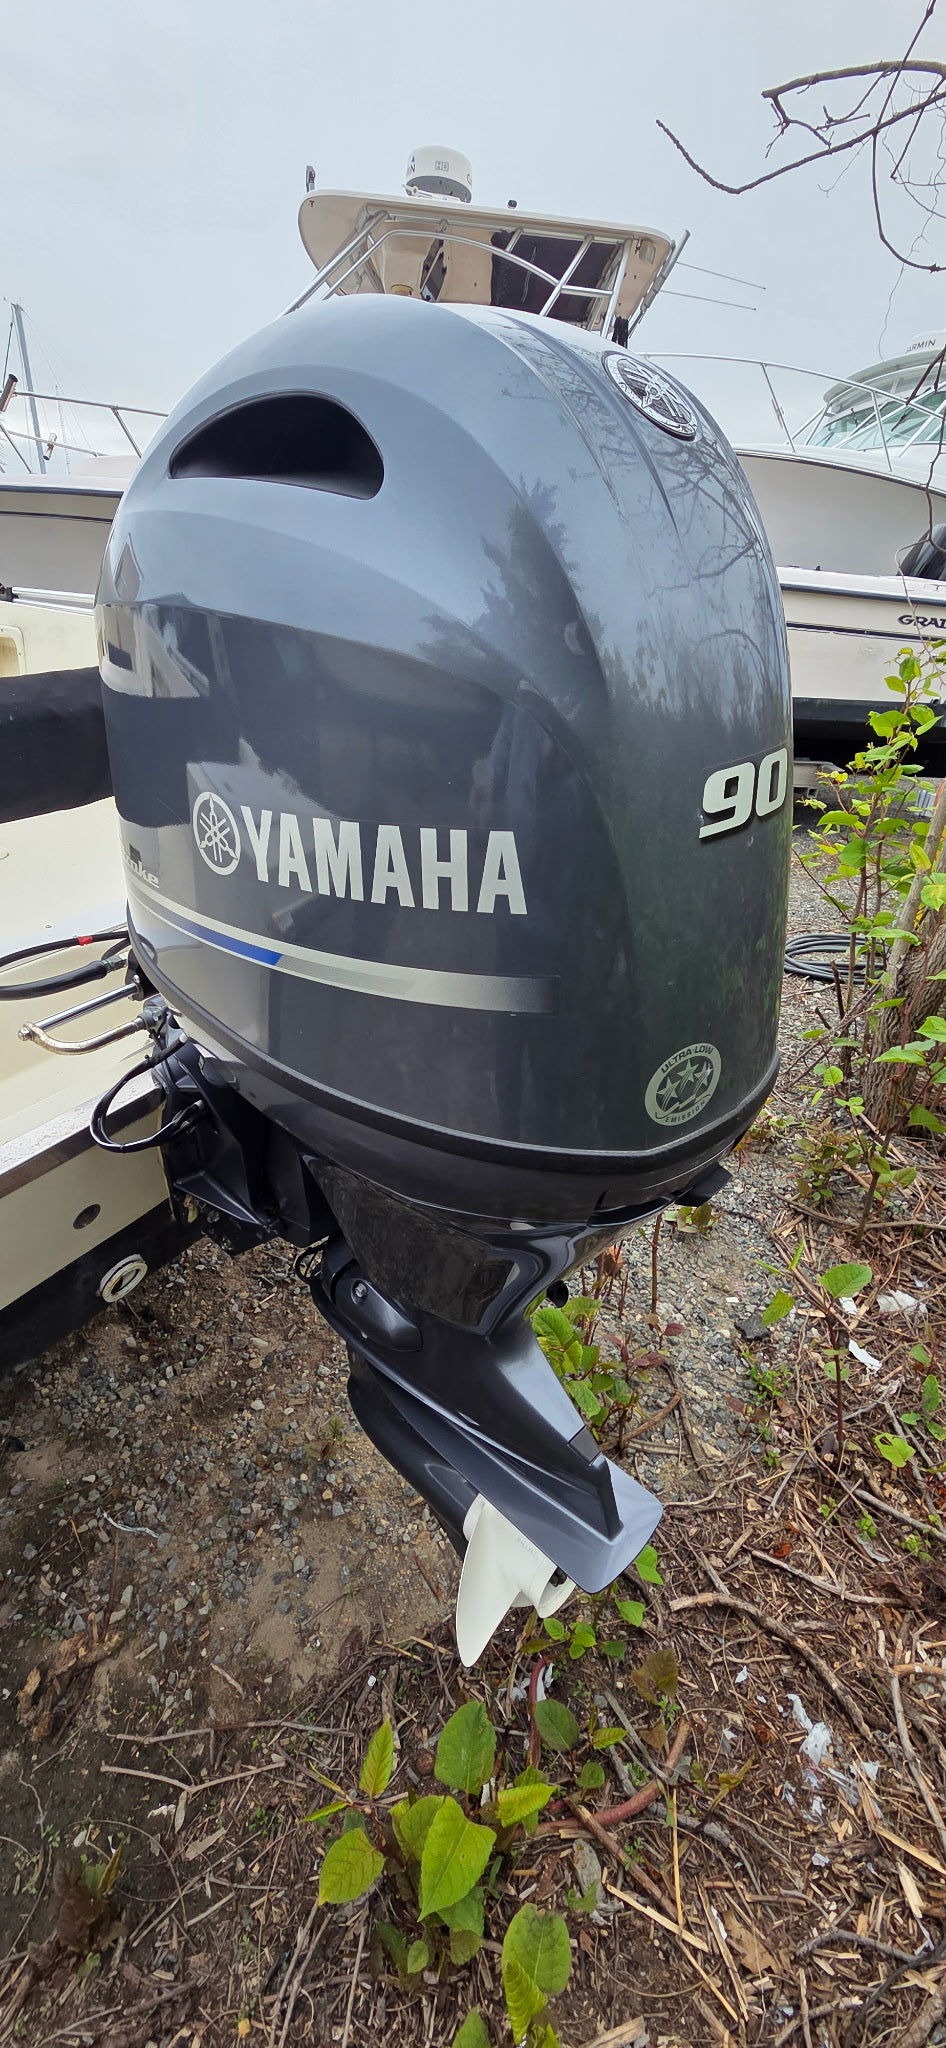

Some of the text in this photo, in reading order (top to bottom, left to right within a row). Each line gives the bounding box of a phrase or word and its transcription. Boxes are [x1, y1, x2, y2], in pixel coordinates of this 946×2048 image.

[904, 339, 936, 353] ARMIN
[699, 747, 788, 839] 90
[240, 805, 528, 915] YAMAHA
[665, 1099, 706, 1123] EMISSION
